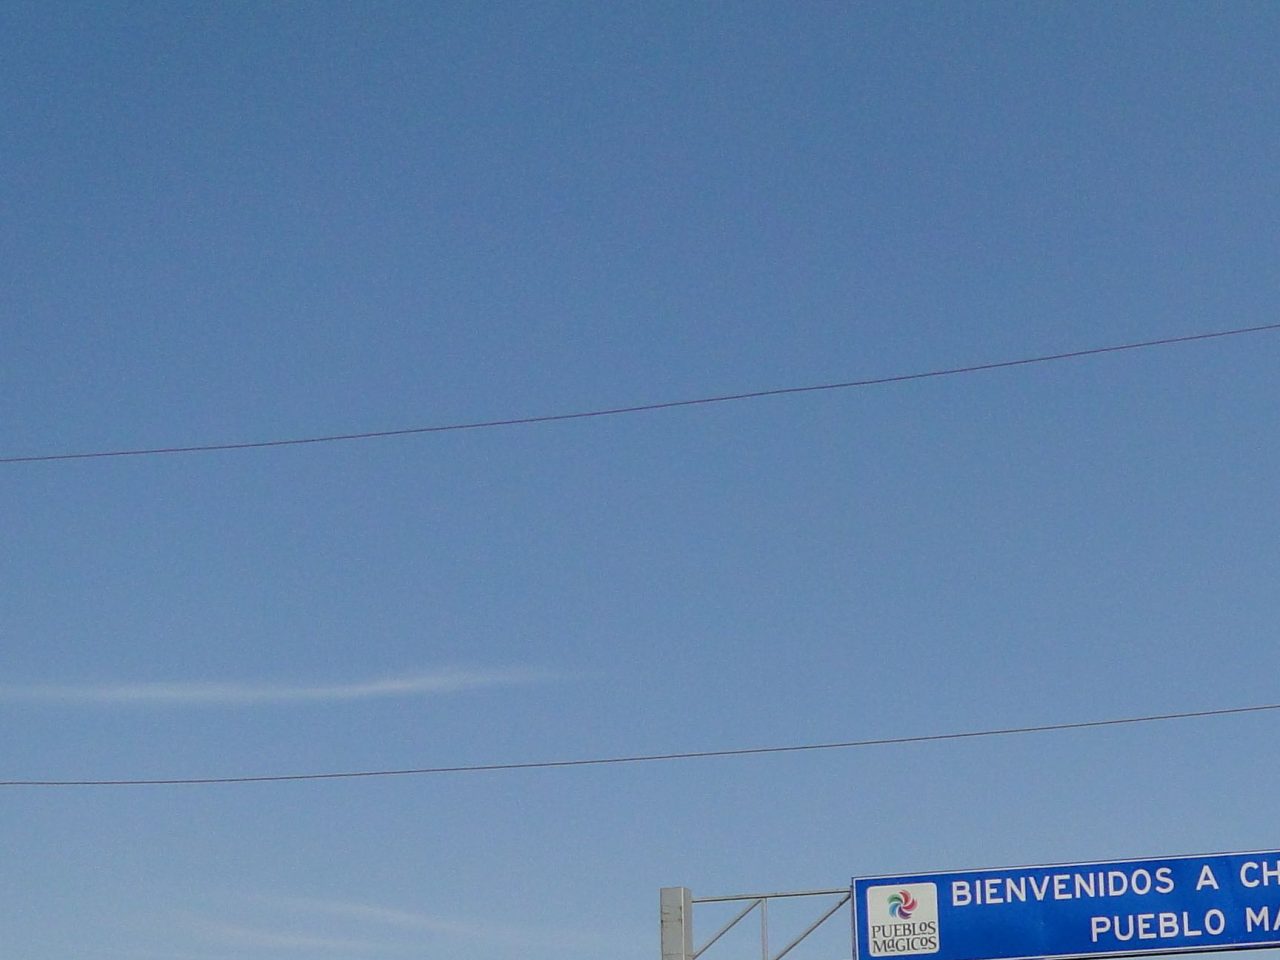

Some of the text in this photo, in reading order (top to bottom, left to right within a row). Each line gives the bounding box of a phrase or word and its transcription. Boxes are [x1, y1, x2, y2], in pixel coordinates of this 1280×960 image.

[952, 867, 1175, 906] BIENVENIDOS
[1196, 865, 1219, 891] A
[1091, 909, 1225, 942] PUEBLO
